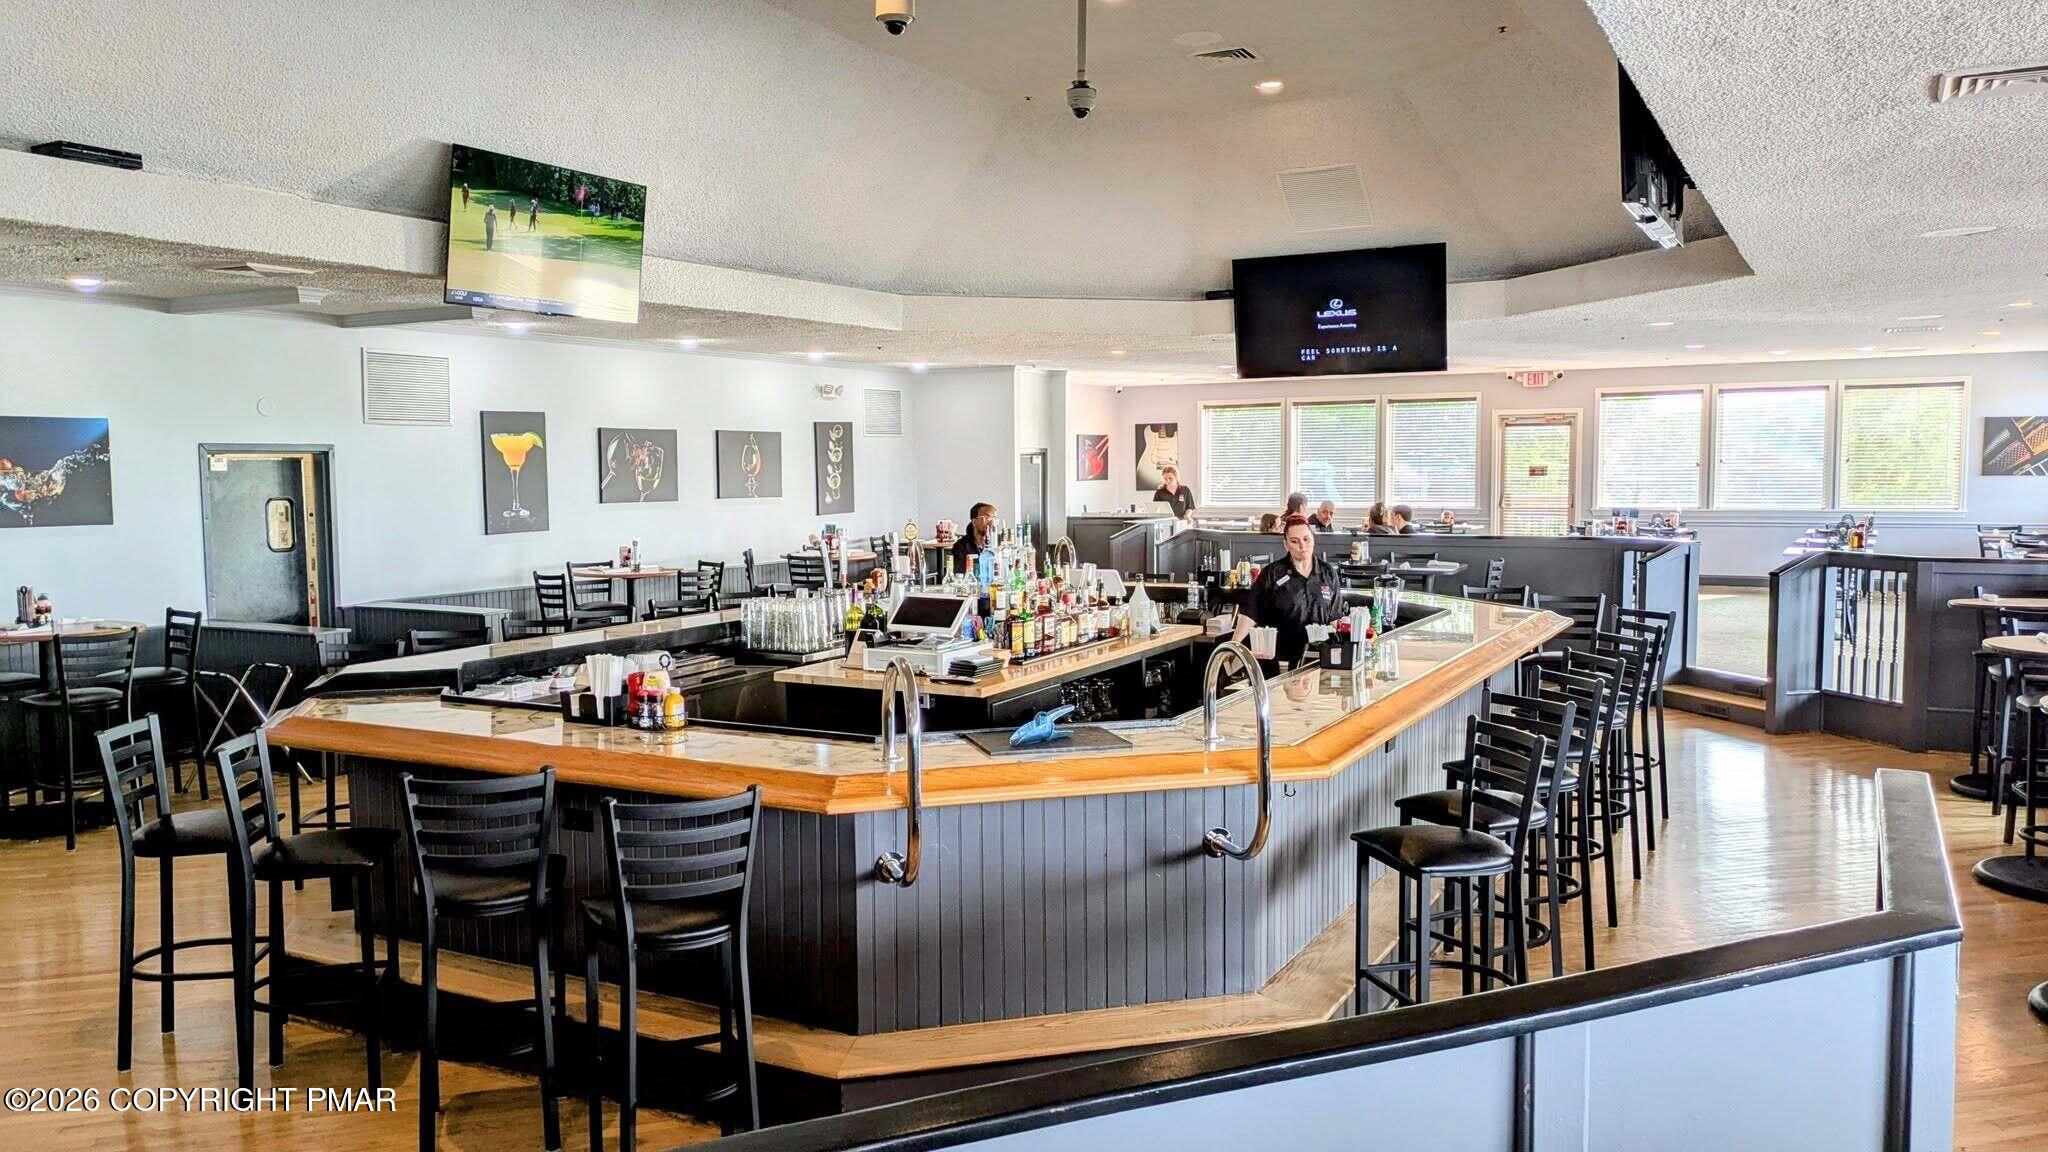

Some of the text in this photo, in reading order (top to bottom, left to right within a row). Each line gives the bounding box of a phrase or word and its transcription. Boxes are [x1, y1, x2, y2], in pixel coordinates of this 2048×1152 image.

[1316, 309, 1357, 317] LEXUS
[1325, 346, 1371, 354] SOMETHING
[1527, 372, 1544, 385] EXIT
